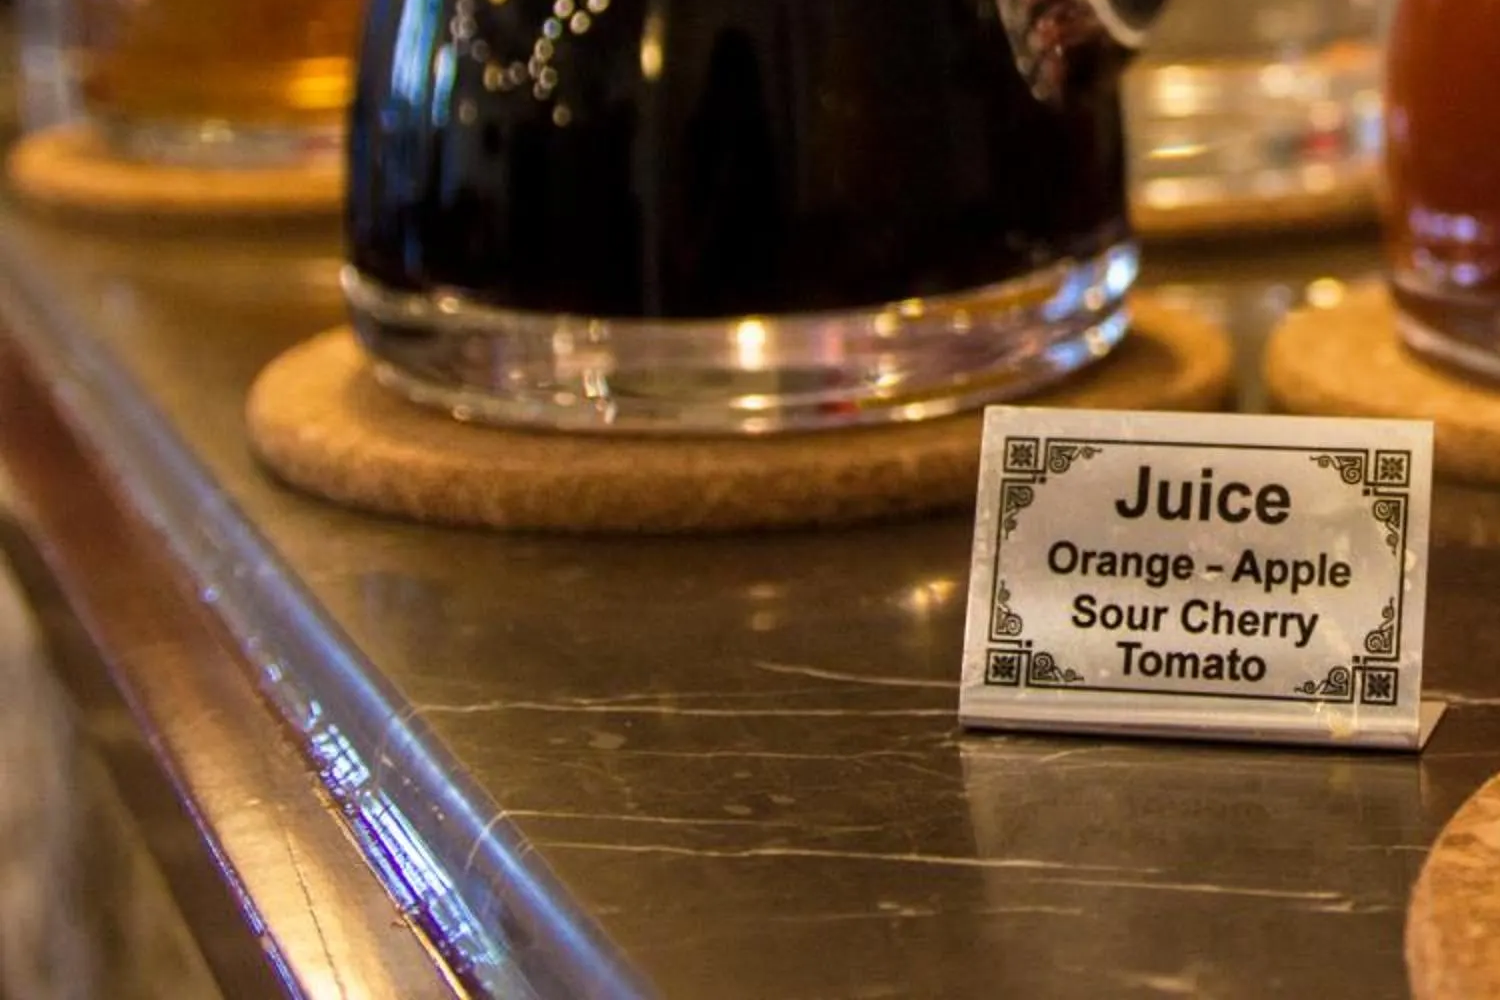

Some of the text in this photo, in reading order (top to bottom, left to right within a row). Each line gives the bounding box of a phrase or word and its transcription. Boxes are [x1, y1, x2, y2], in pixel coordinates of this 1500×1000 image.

[1115, 465, 1291, 525] Juice
[1047, 540, 1195, 588] Orange
[1231, 549, 1353, 593] Apple
[1071, 594, 1319, 648] Sour Cherry
[1116, 641, 1267, 683] Tomato
